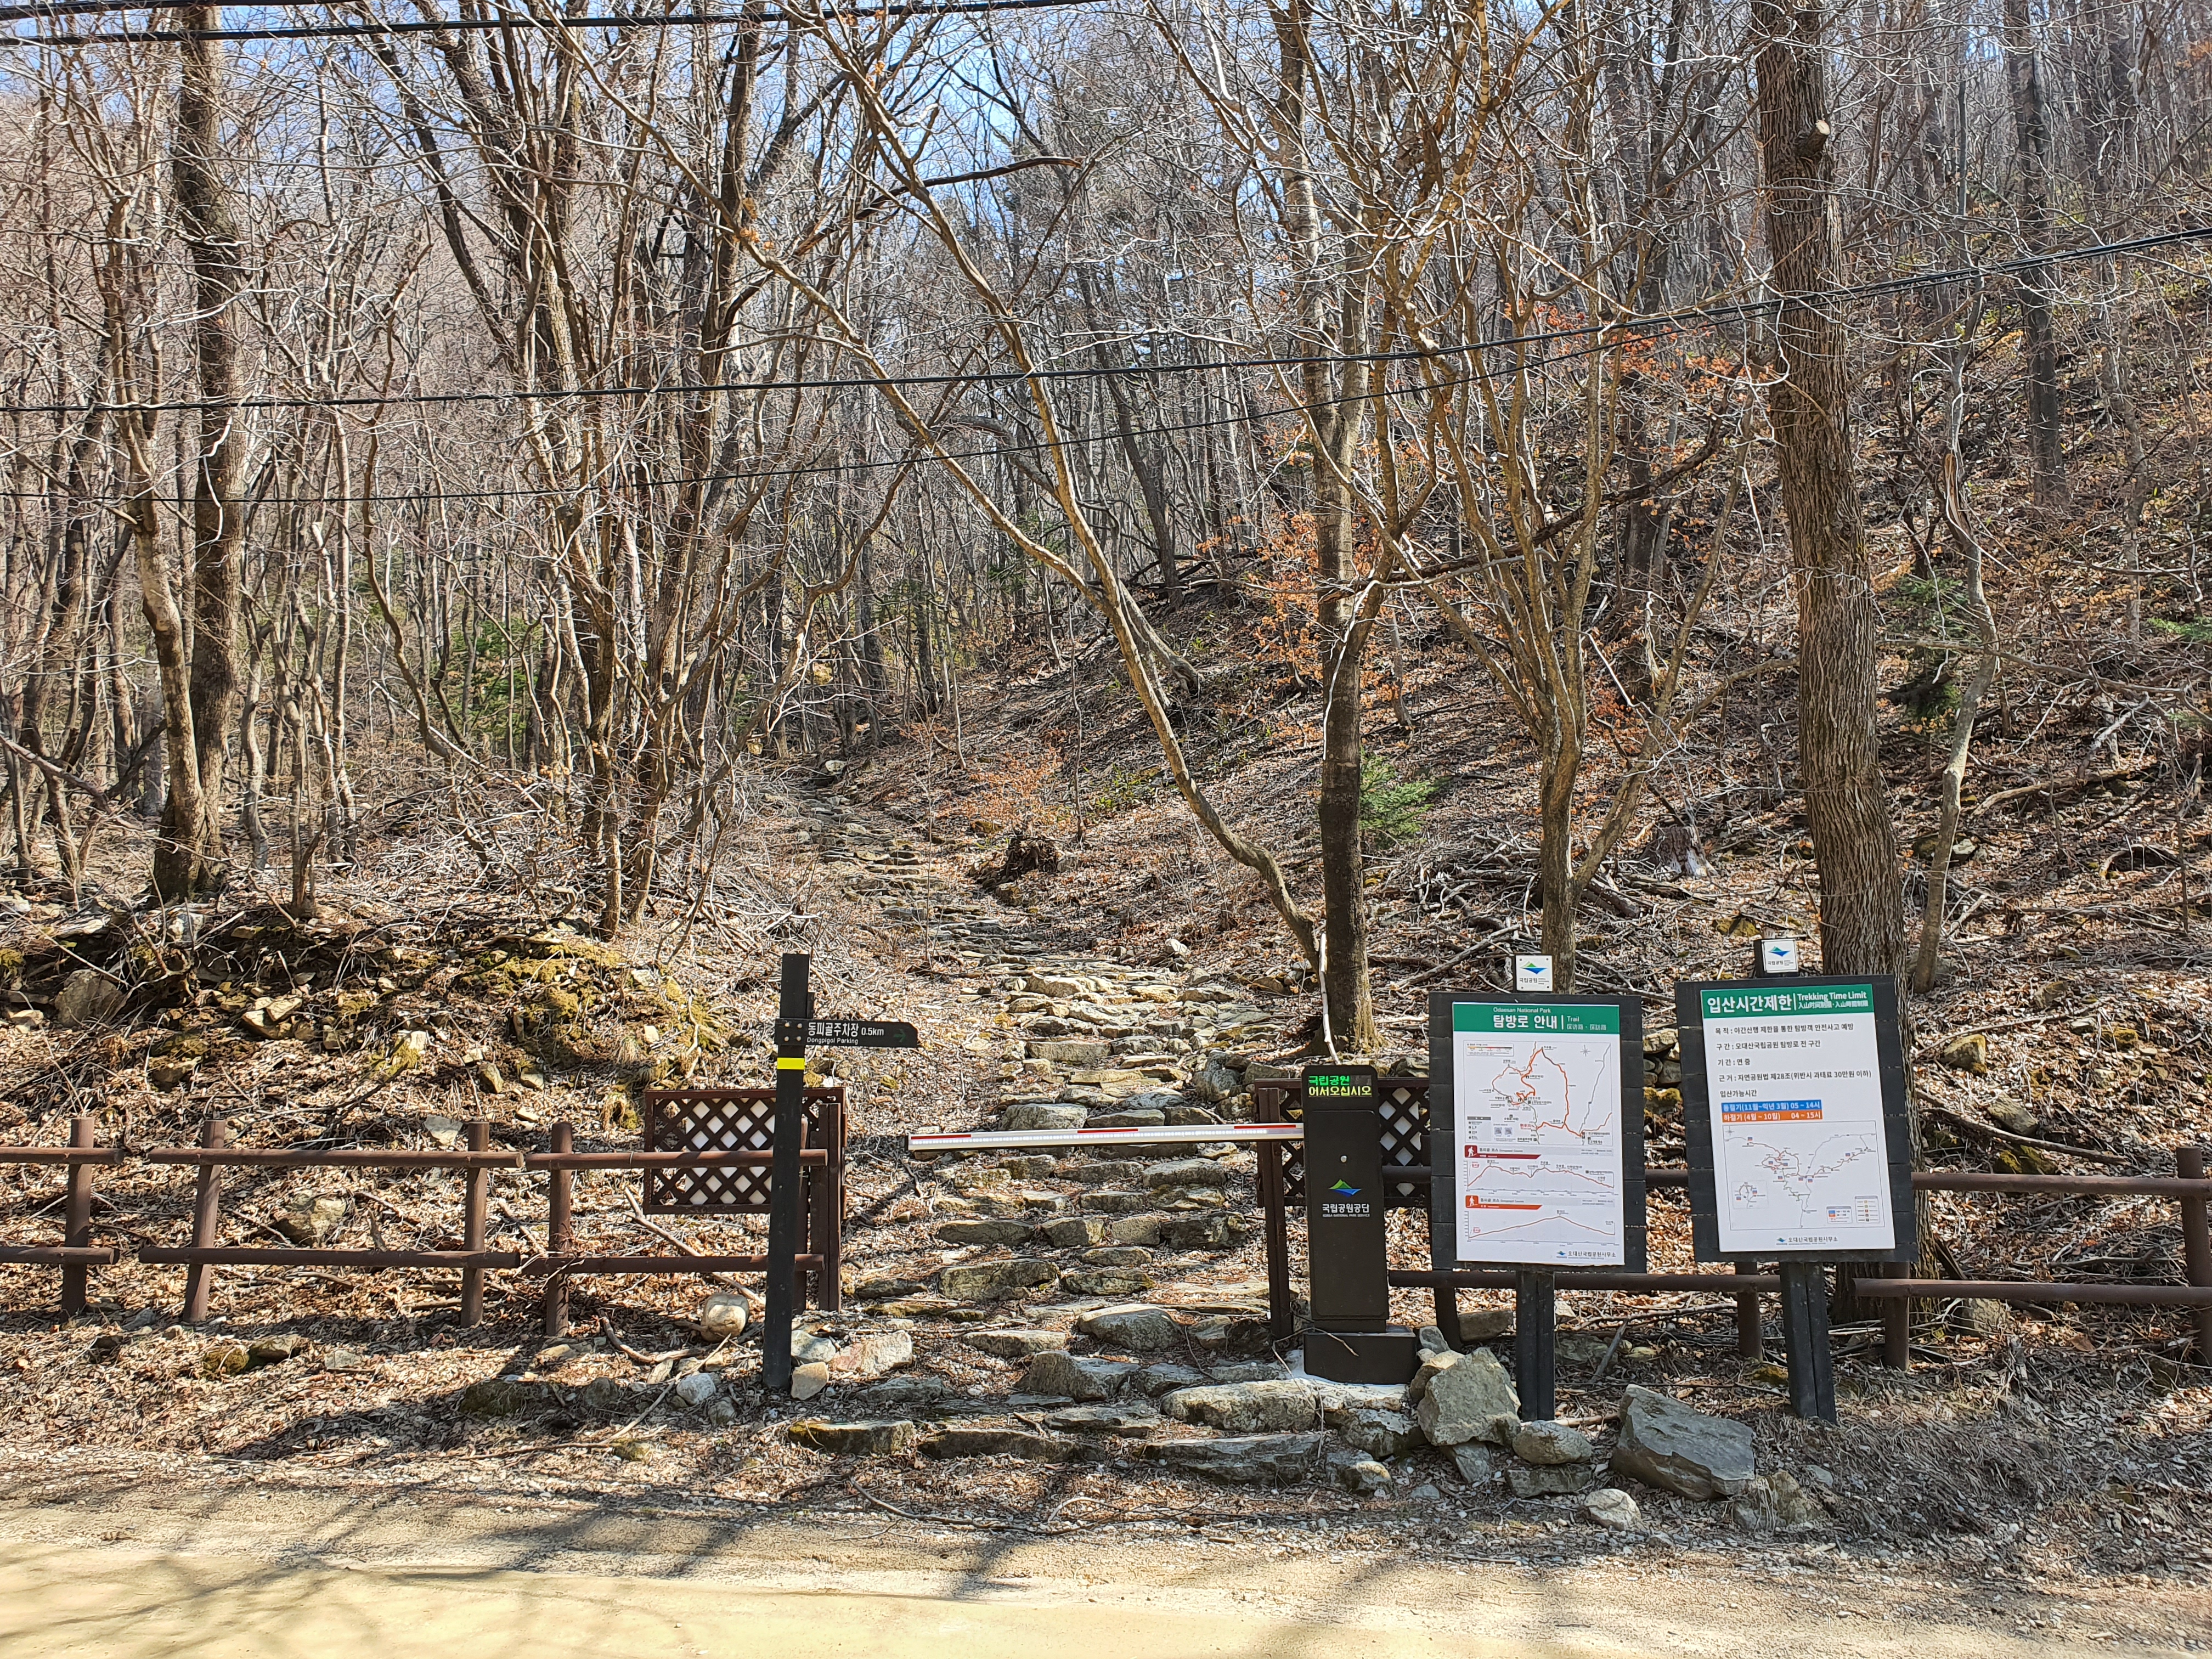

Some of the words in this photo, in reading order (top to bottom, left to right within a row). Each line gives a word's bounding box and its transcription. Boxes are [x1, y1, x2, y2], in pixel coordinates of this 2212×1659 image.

[1797, 992, 1829, 1002] Trekking
[1829, 992, 1847, 1000] Time
[1848, 991, 1867, 999] Limit
[1707, 994, 1792, 1013] 입산시간제한
[1493, 1015, 1529, 1029] 탐방로
[1534, 1015, 1558, 1029] 안내
[808, 1022, 859, 1037] 동피골주차장
[861, 1027, 884, 1036] 0.5km
[1735, 1041, 1779, 1049] 오대산국립공원
[1308, 1075, 1350, 1086] 국립공원
[1738, 1073, 1769, 1081] 자연공원법
[1309, 1086, 1372, 1096] 어서오십시오
[1720, 1090, 1757, 1098] 입산가능시간
[1322, 1204, 1369, 1214] 국립공원공단
